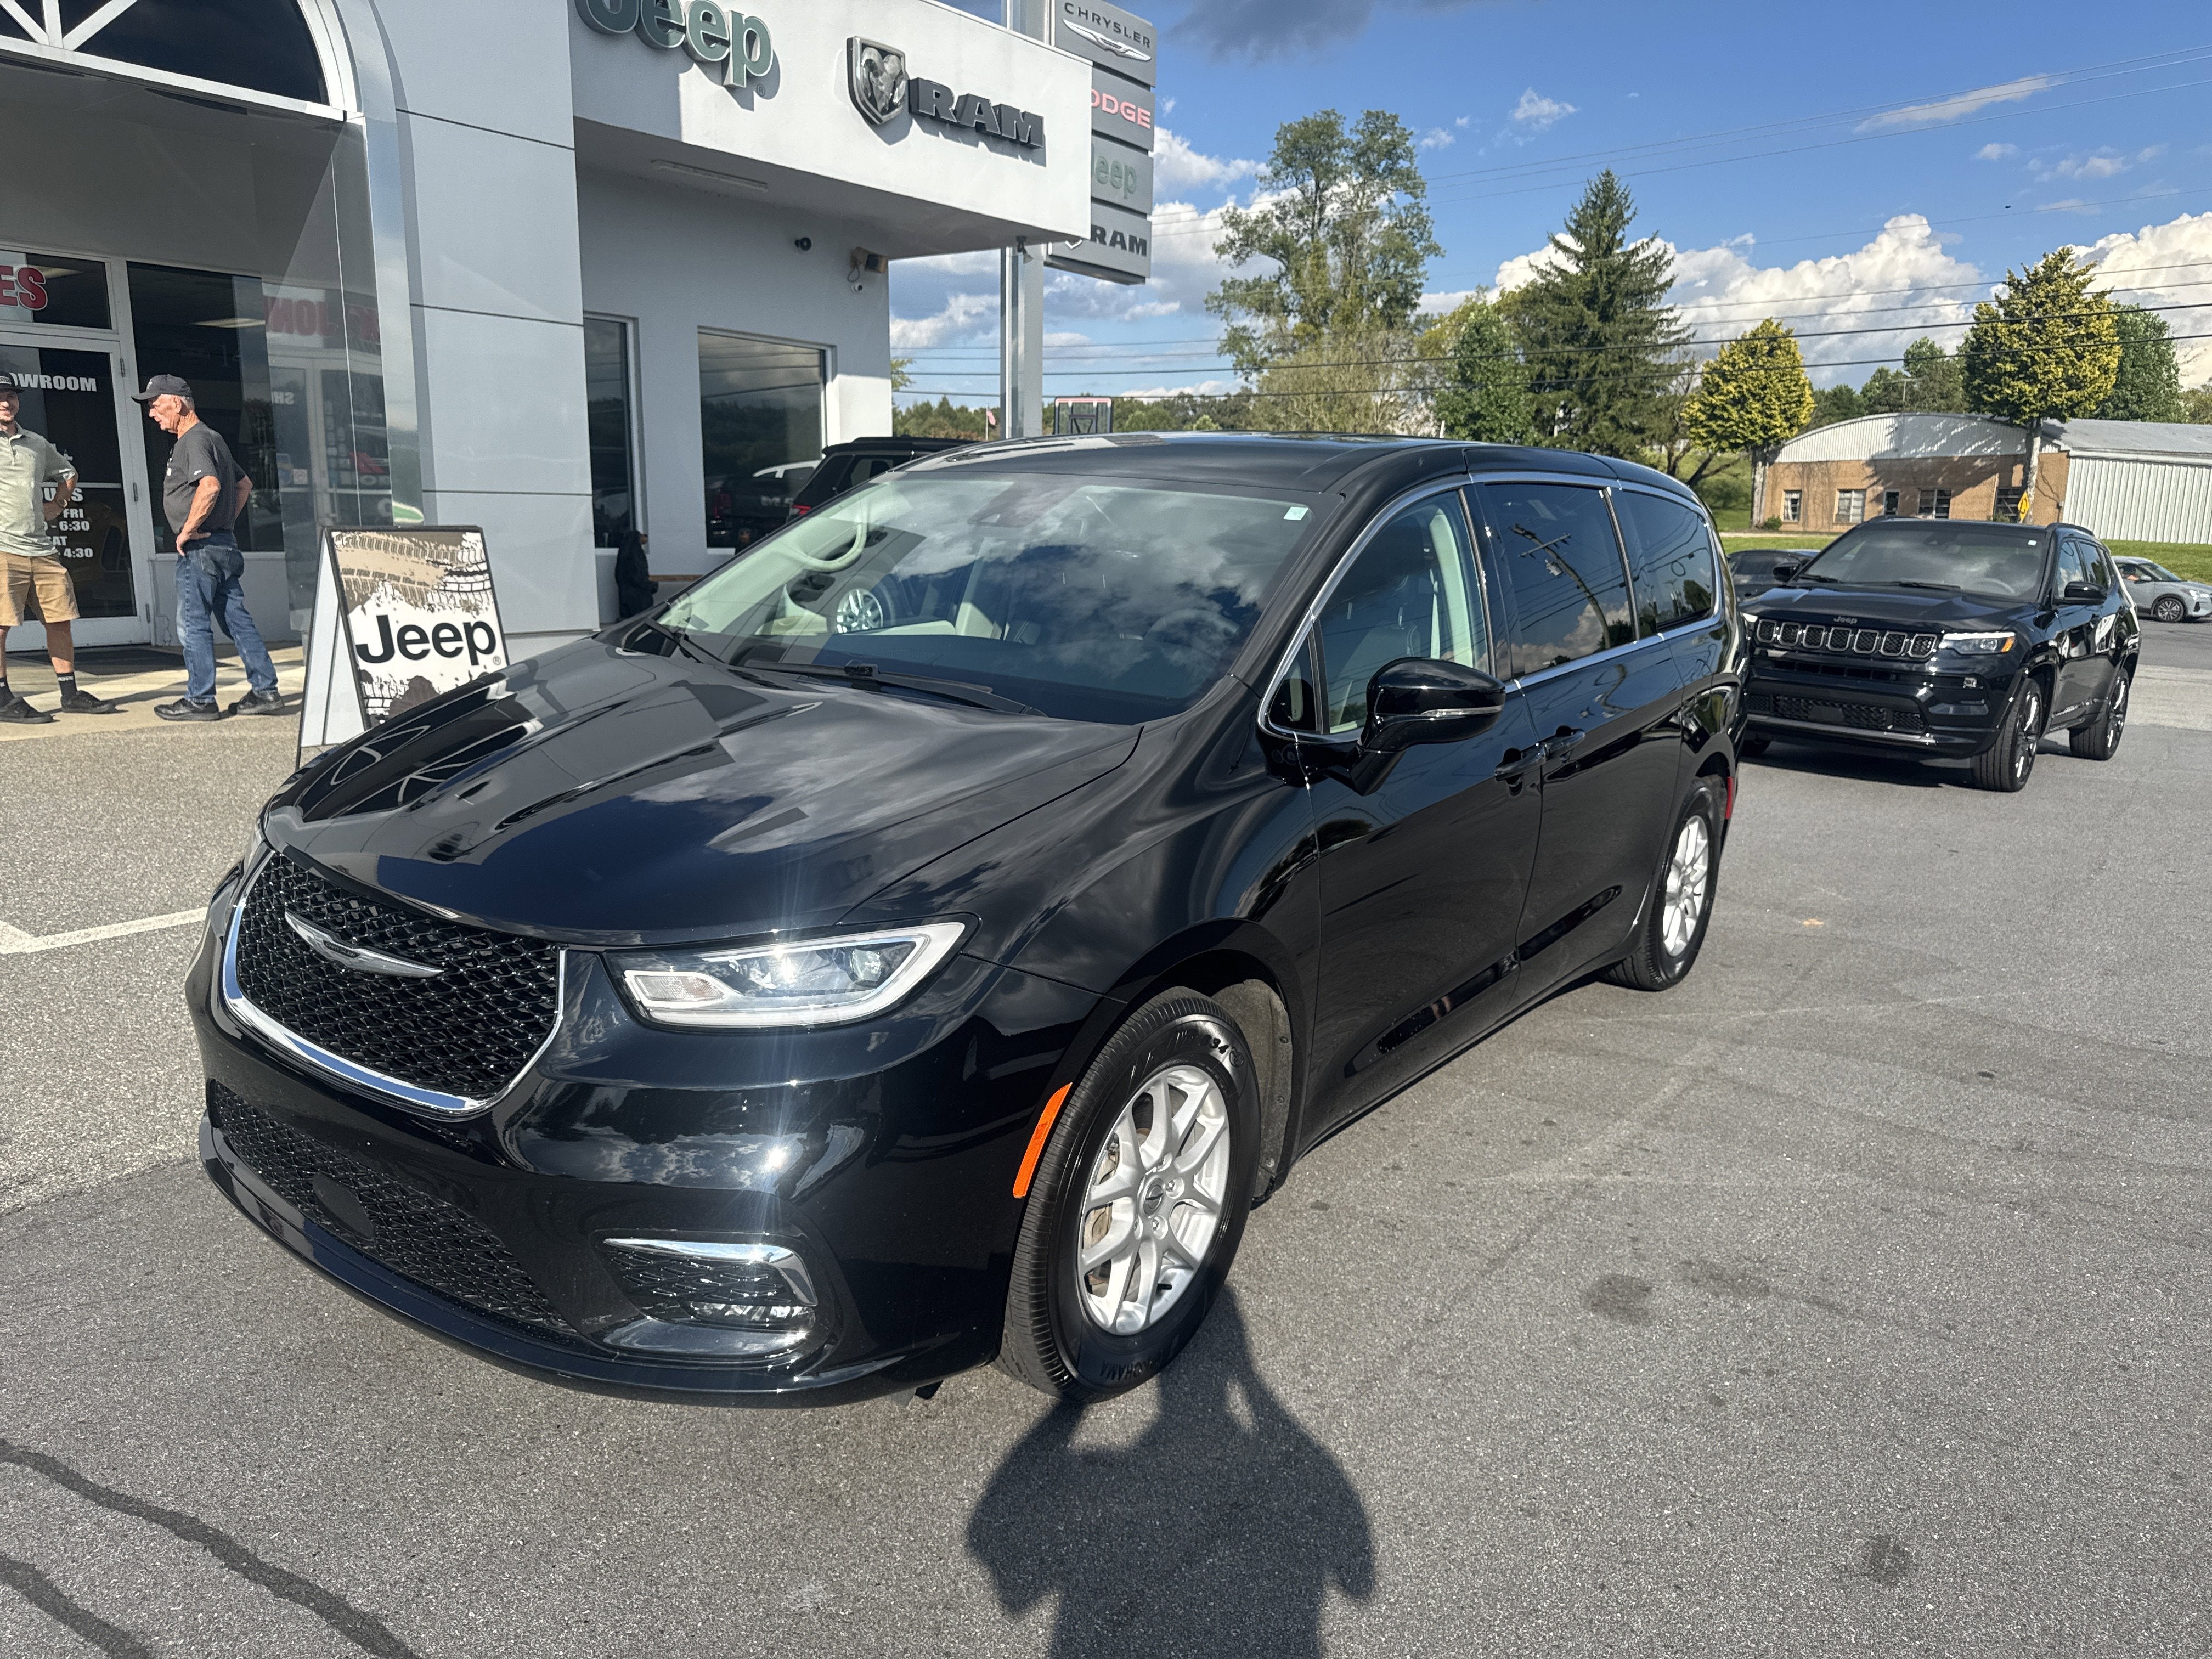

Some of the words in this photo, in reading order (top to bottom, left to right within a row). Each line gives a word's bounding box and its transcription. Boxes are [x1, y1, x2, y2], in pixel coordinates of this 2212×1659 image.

[1064, 2, 1150, 48] CHRYSLER
[910, 77, 1045, 148] RAM
[1091, 144, 1137, 199] eep
[1090, 223, 1147, 256] RAM
[63, 508, 84, 518] FRI
[59, 521, 90, 531] 6:30
[47, 535, 68, 546] AT
[63, 548, 93, 558] 4:30
[1833, 616, 1858, 624] Jeep
[356, 614, 496, 666] Jeep
